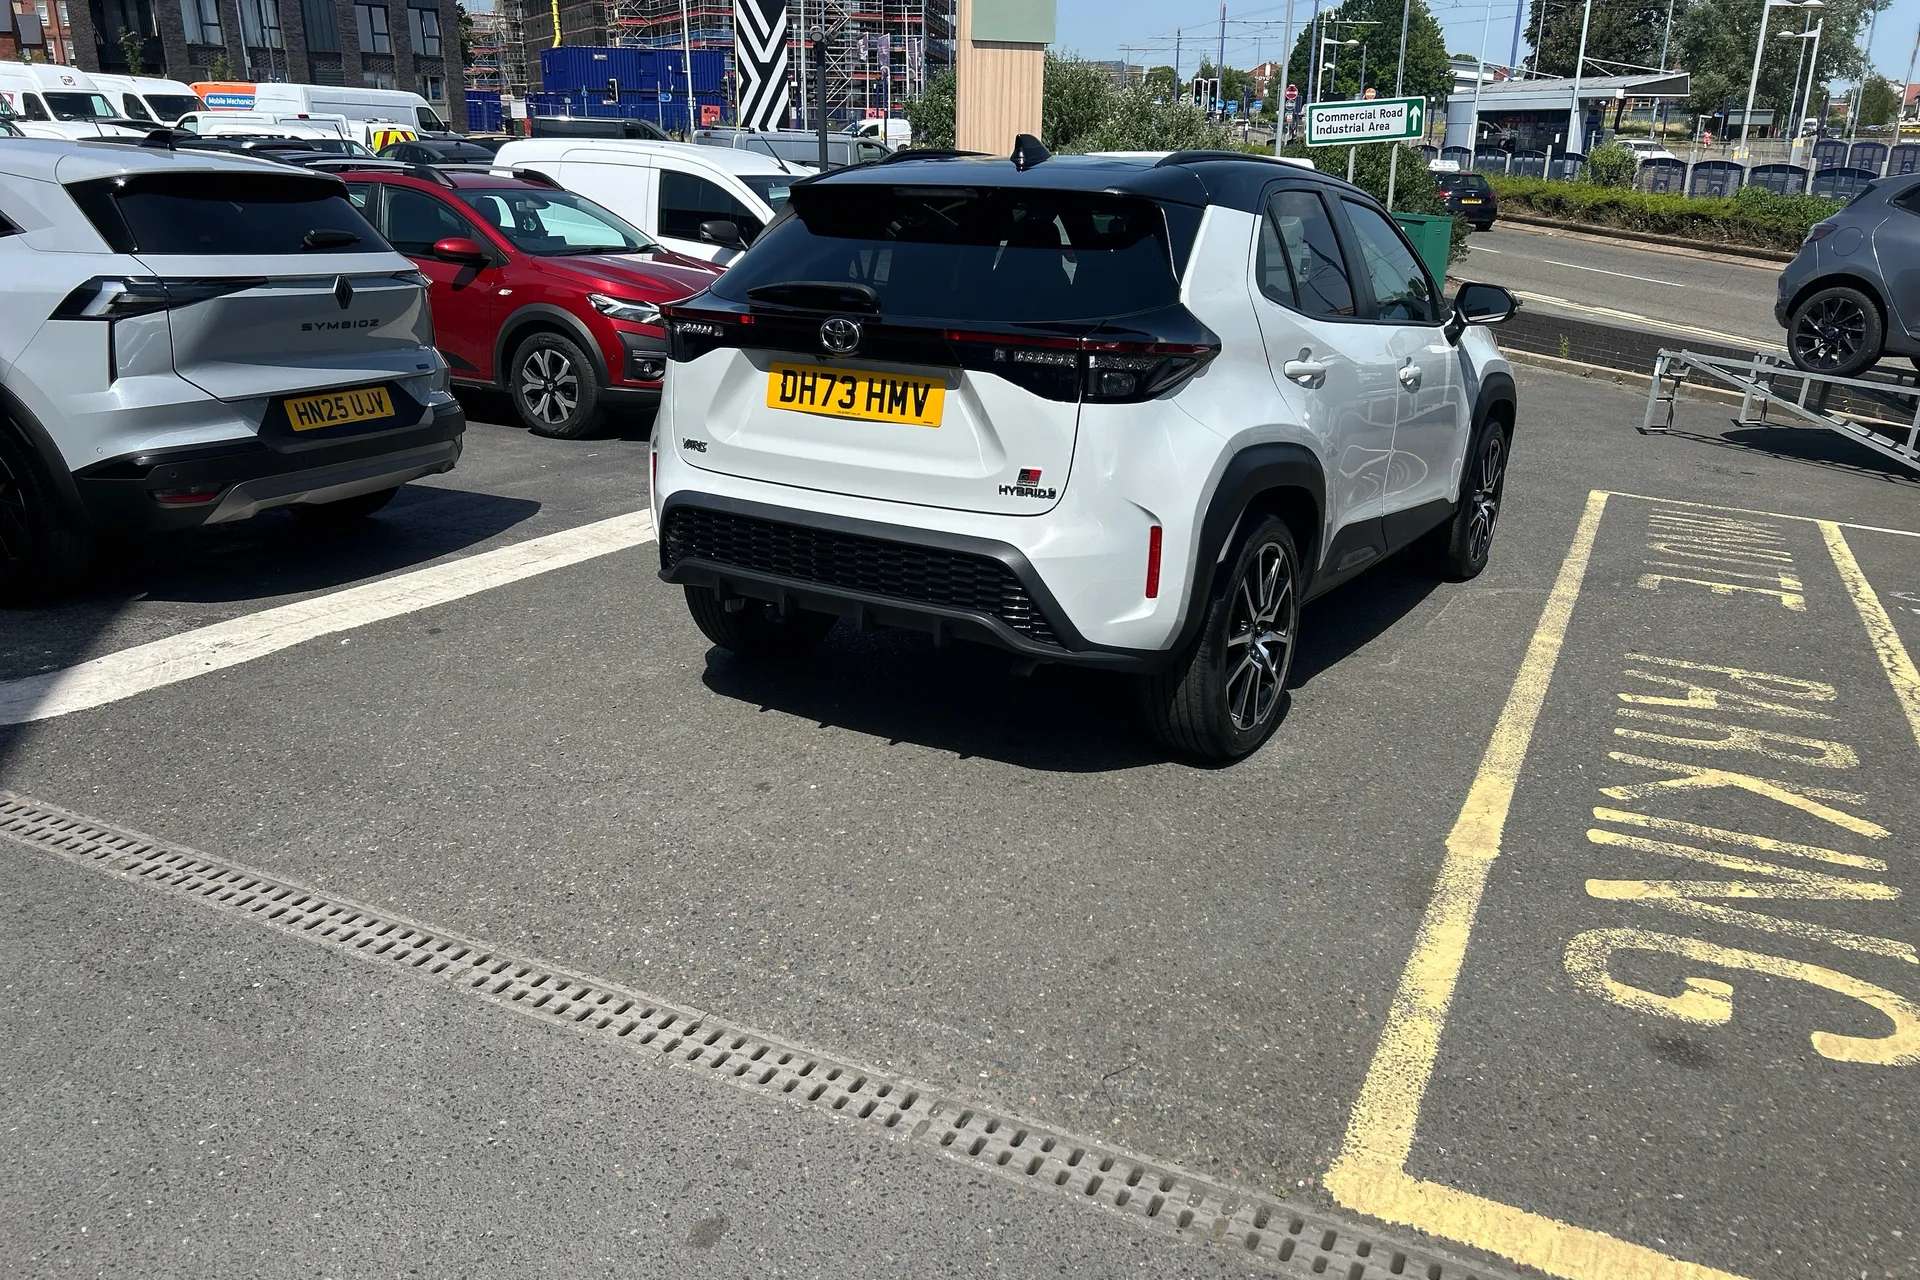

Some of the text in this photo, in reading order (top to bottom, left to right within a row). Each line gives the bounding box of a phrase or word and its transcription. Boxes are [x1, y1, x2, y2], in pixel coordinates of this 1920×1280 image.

[208, 97, 226, 105] Mobile
[1316, 107, 1403, 123] Commercial Road
[1316, 122, 1390, 135] Industrial Area
[301, 318, 380, 332] SYMBIOZ
[780, 369, 931, 418] DH73 HMV
[294, 391, 385, 426] HN25 UJV
[998, 485, 1047, 499] HYBRID
[1563, 506, 1920, 1067] MINUTE PARKING
